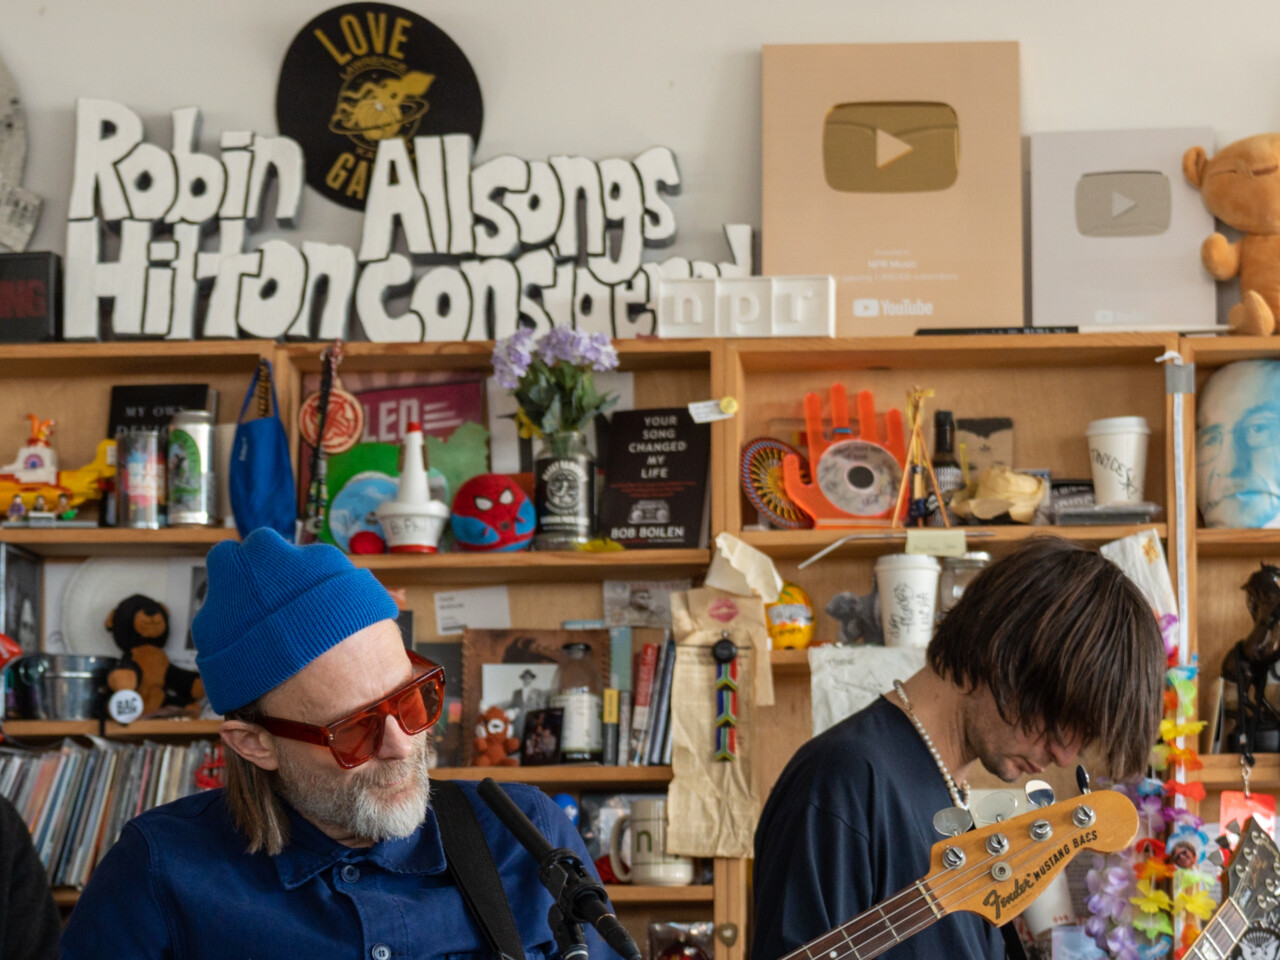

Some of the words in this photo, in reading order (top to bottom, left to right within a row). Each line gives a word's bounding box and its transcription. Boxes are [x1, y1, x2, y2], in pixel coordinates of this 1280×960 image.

[314, 12, 413, 66] LOVE
[69, 97, 306, 224] Robin
[359, 134, 680, 285] Allsongs
[867, 259, 891, 270] NPR
[893, 259, 917, 270] Music
[672, 288, 814, 333] npr
[881, 299, 934, 316] YouTube
[124, 406, 147, 417] MY
[644, 416, 678, 427] YOUR
[642, 429, 676, 440] SONG
[628, 441, 687, 453] CHANGED
[646, 455, 666, 465] MY
[641, 468, 668, 479] LIFE
[610, 527, 637, 539] BOB
[639, 526, 685, 538] BOILEN
[1033, 844, 1071, 882] MUSTANG
[983, 878, 1035, 920] Fender
